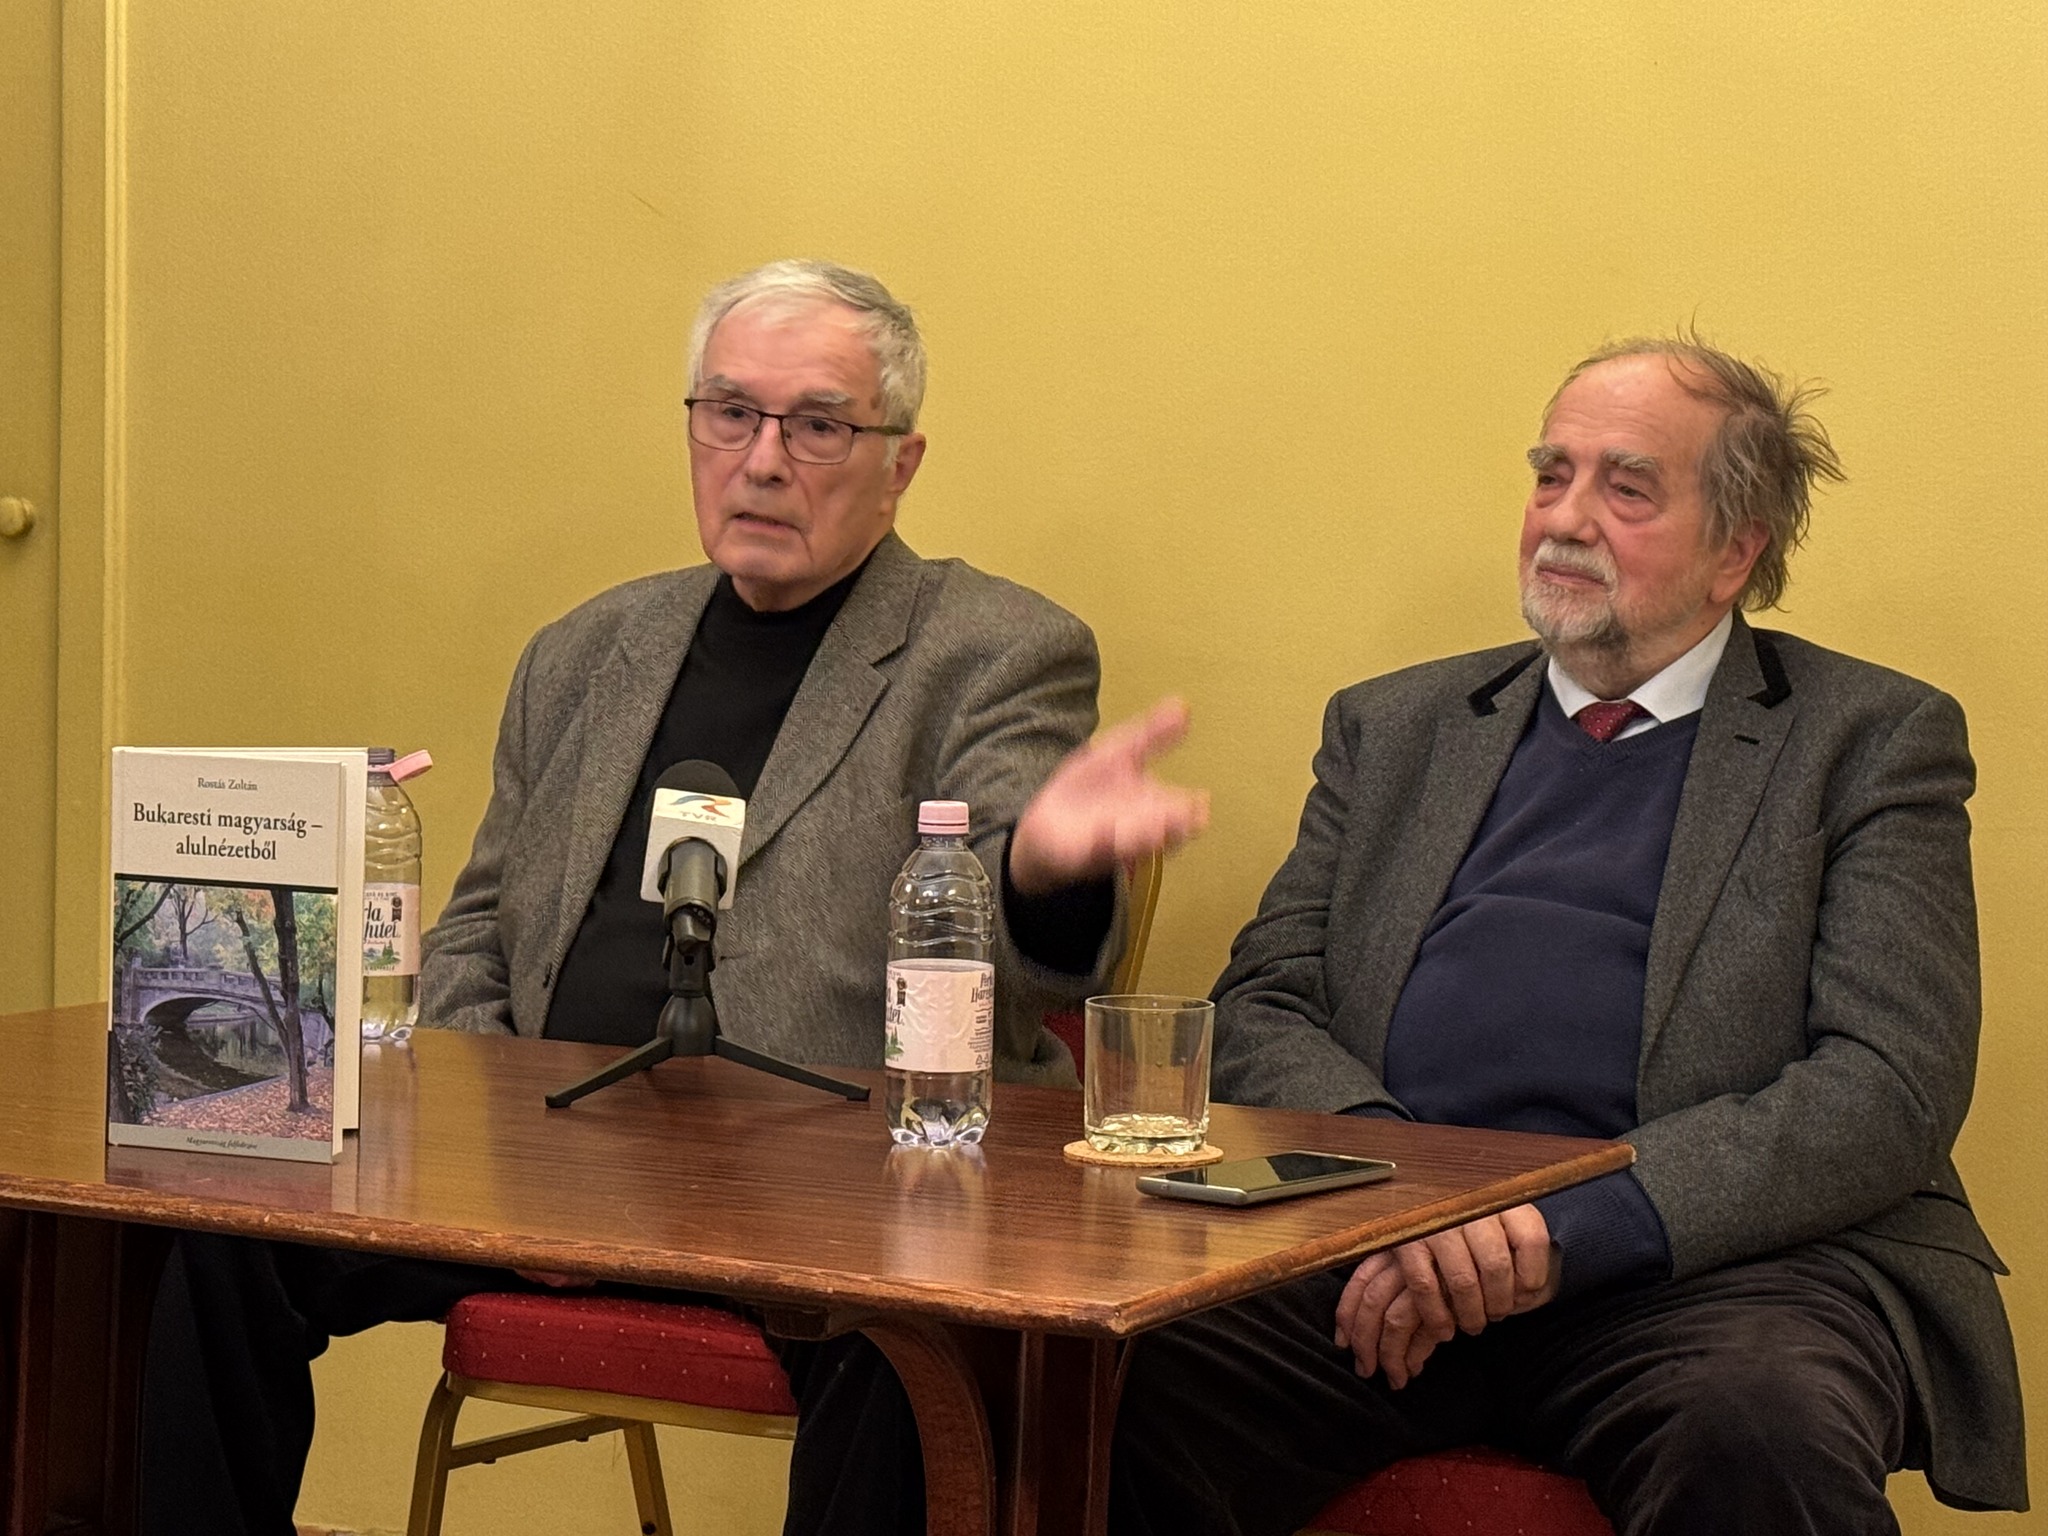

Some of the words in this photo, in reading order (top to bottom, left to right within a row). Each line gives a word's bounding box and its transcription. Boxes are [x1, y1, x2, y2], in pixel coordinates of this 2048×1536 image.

[197, 777, 226, 789] Rostás
[228, 779, 258, 791] Zoltán
[133, 802, 212, 826] Bukaresti
[218, 812, 307, 838] magyarság
[176, 835, 276, 860] alulnézetből
[363, 900, 384, 922] la
